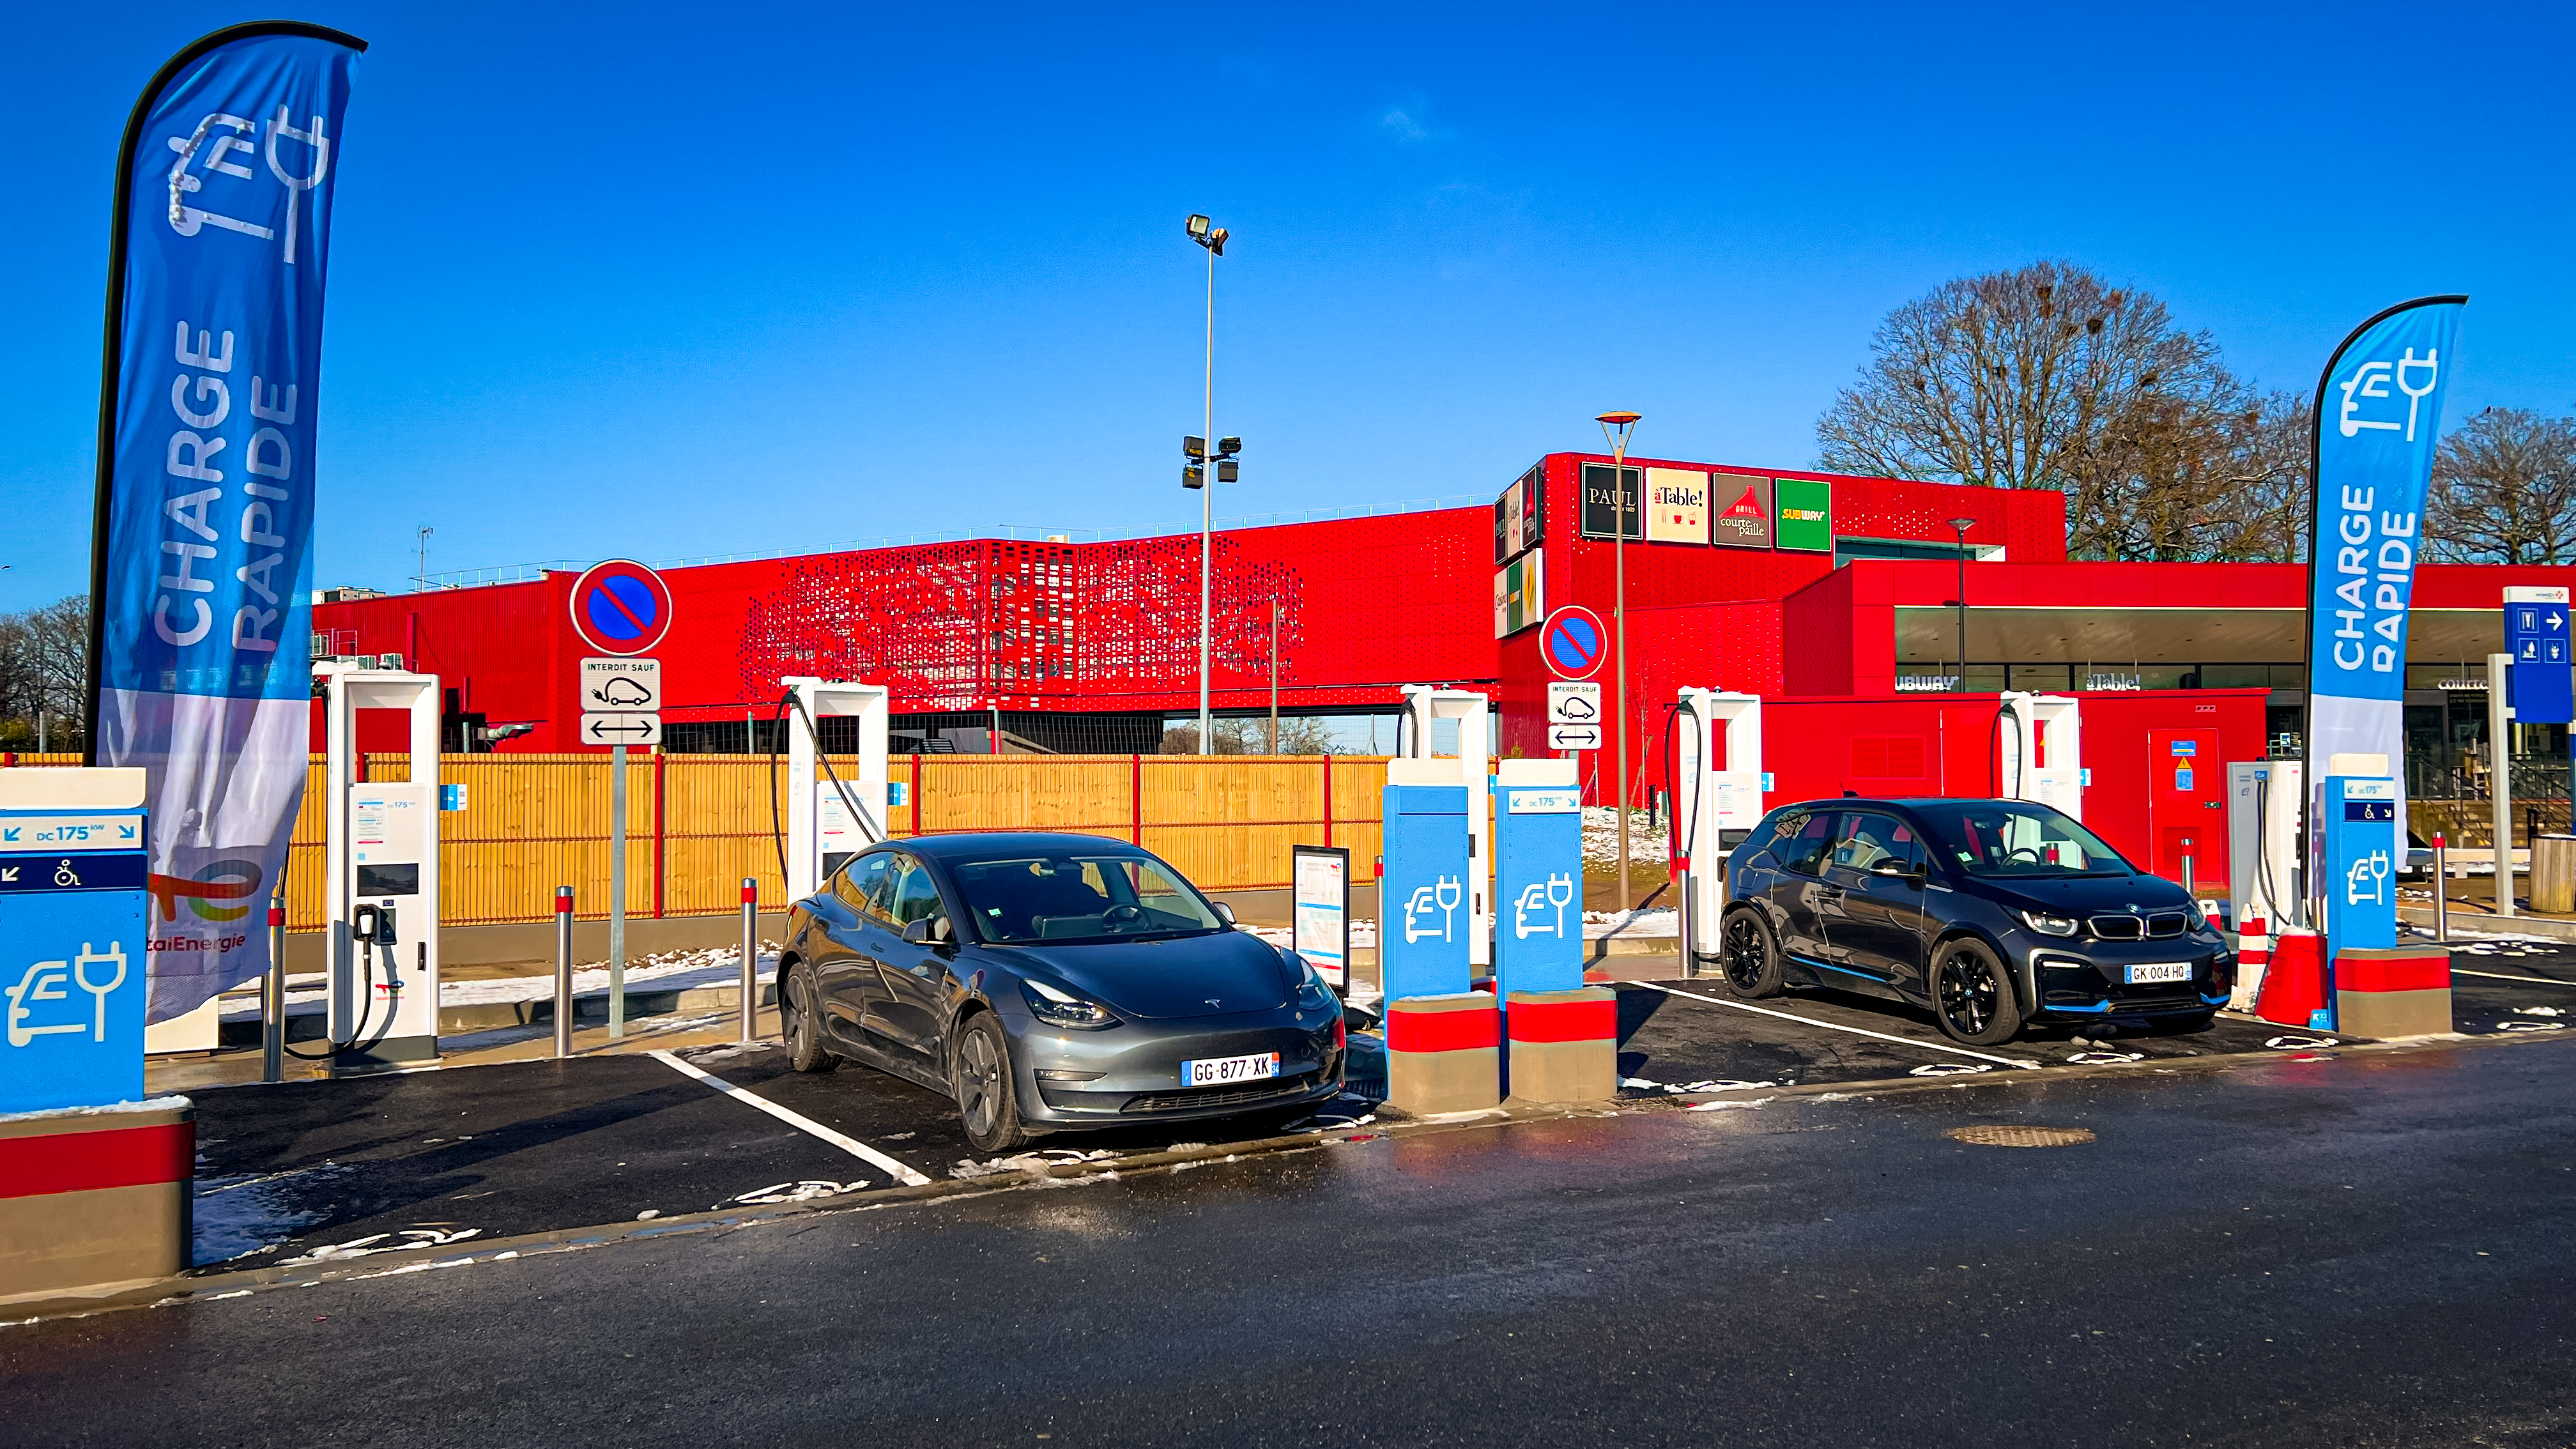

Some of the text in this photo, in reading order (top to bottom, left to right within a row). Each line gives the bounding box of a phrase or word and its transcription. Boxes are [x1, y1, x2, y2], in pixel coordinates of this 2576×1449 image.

[155, 320, 234, 647] CHARGE
[1588, 487, 1636, 507] PAUL
[231, 376, 297, 652] RAPIDE
[1735, 505, 1757, 515] GRILL
[1782, 508, 1825, 522] SUBWAY
[1720, 518, 1752, 528] courte
[1738, 523, 1765, 537] paille
[2333, 484, 2375, 671] CHARGE
[2372, 510, 2416, 673] RAPIDE
[1538, 797, 1554, 807] 175
[36, 832, 54, 841] DC
[56, 826, 88, 841] 175
[1271, 1064, 1280, 1074] 34
